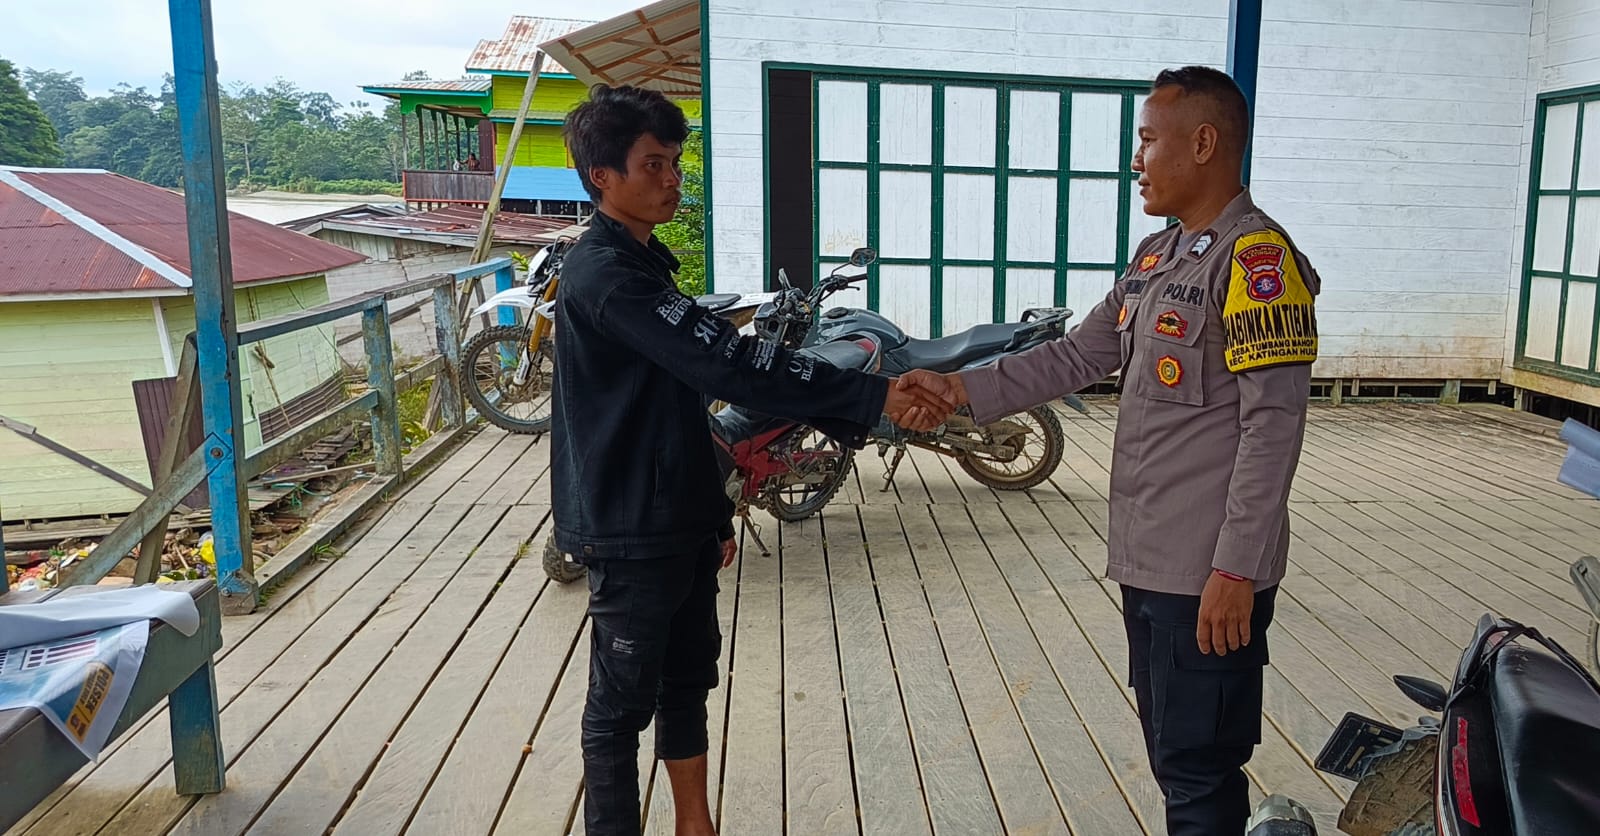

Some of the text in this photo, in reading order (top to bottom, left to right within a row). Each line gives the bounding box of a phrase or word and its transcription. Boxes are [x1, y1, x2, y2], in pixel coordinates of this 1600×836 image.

[1162, 282, 1205, 307] POLRI
[1231, 345, 1251, 358] DESA
[1250, 339, 1290, 352] TUMBANG
[1248, 348, 1299, 362] KATINGAN
[85, 671, 110, 715] POLSEK
